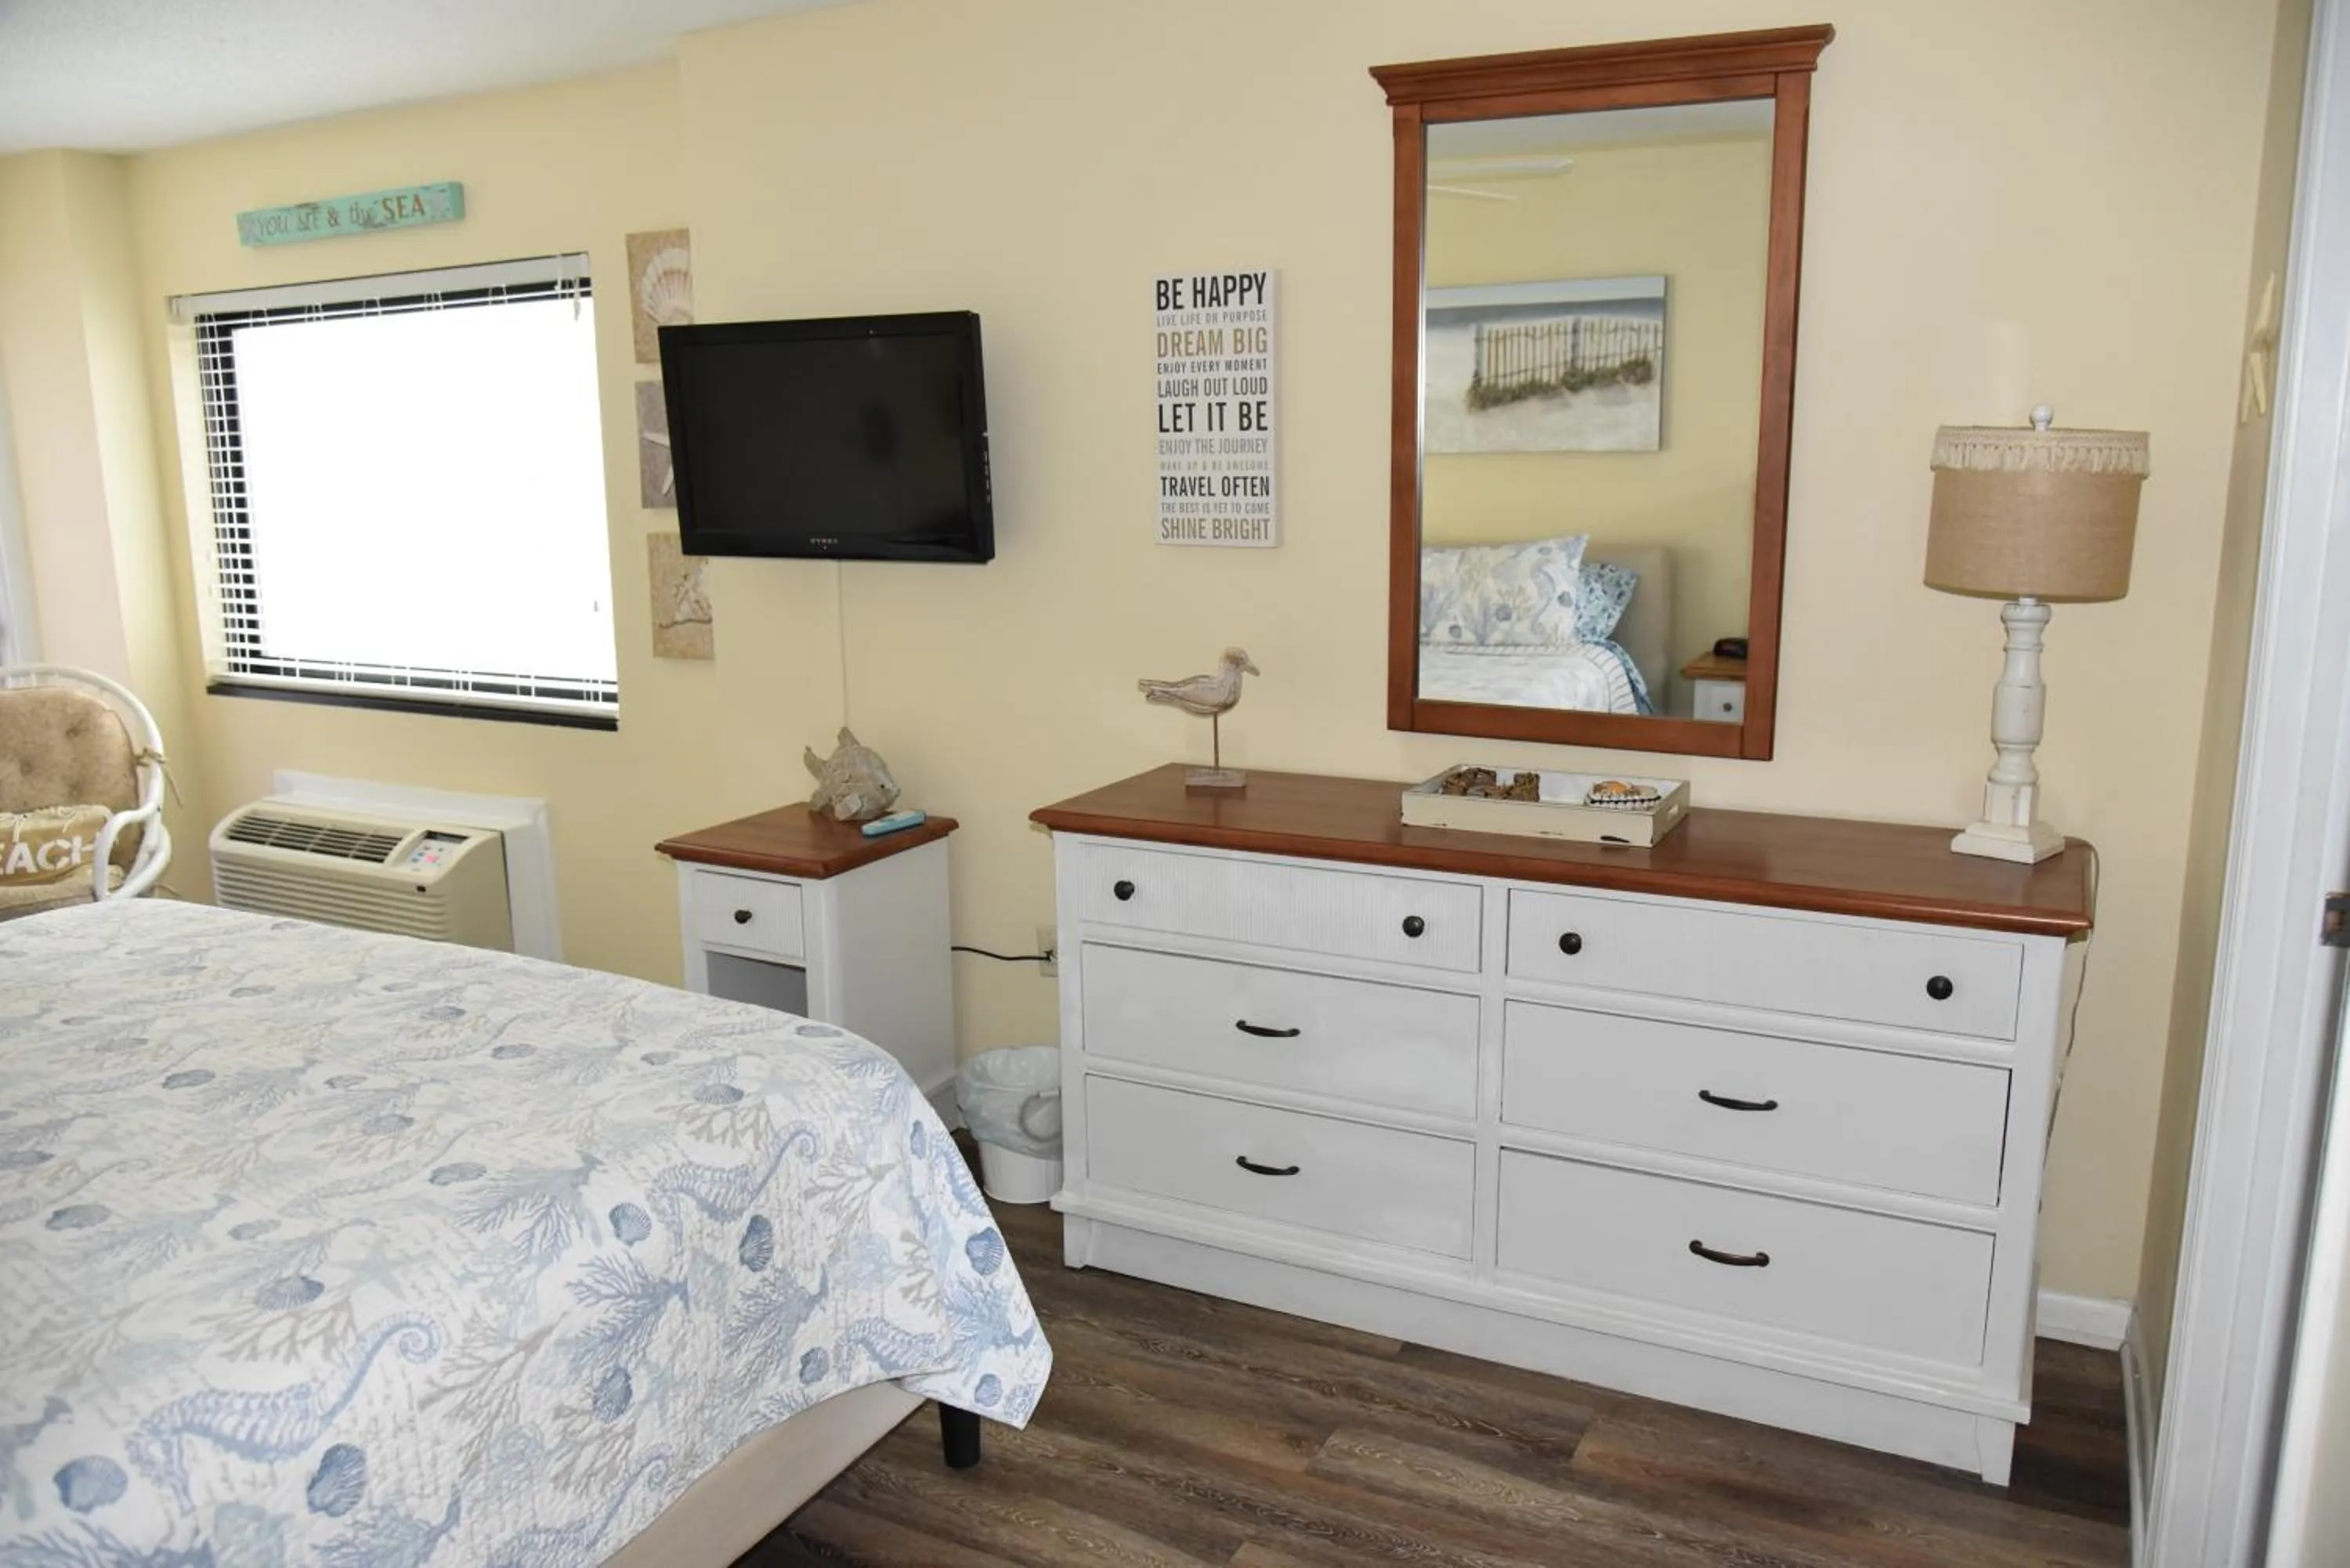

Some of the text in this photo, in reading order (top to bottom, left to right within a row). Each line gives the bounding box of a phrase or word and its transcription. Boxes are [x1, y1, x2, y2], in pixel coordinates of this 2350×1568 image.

[381, 193, 426, 221] SEA
[1156, 272, 1267, 311] BE HAPPY
[1157, 314, 1177, 327] LIVE
[1180, 313, 1201, 326] LIFE
[1223, 309, 1267, 323] PURPOSE
[1157, 327, 1267, 358] DREAM BIG
[1157, 358, 1267, 374] ENJOY EVERY MOMENT
[1157, 376, 1267, 398] LAUGH OUT LOUD
[1158, 400, 1268, 432] LET IT BE
[1159, 439, 1268, 455] ENJOY THE JOURNEY
[1160, 475, 1270, 497] TRAVEL OFTEN
[1161, 502, 1176, 514] THE
[1179, 502, 1198, 514] BEST
[1231, 502, 1242, 514] TO
[1245, 502, 1271, 514] COME
[1161, 518, 1271, 540] SHINE BRIGHT
